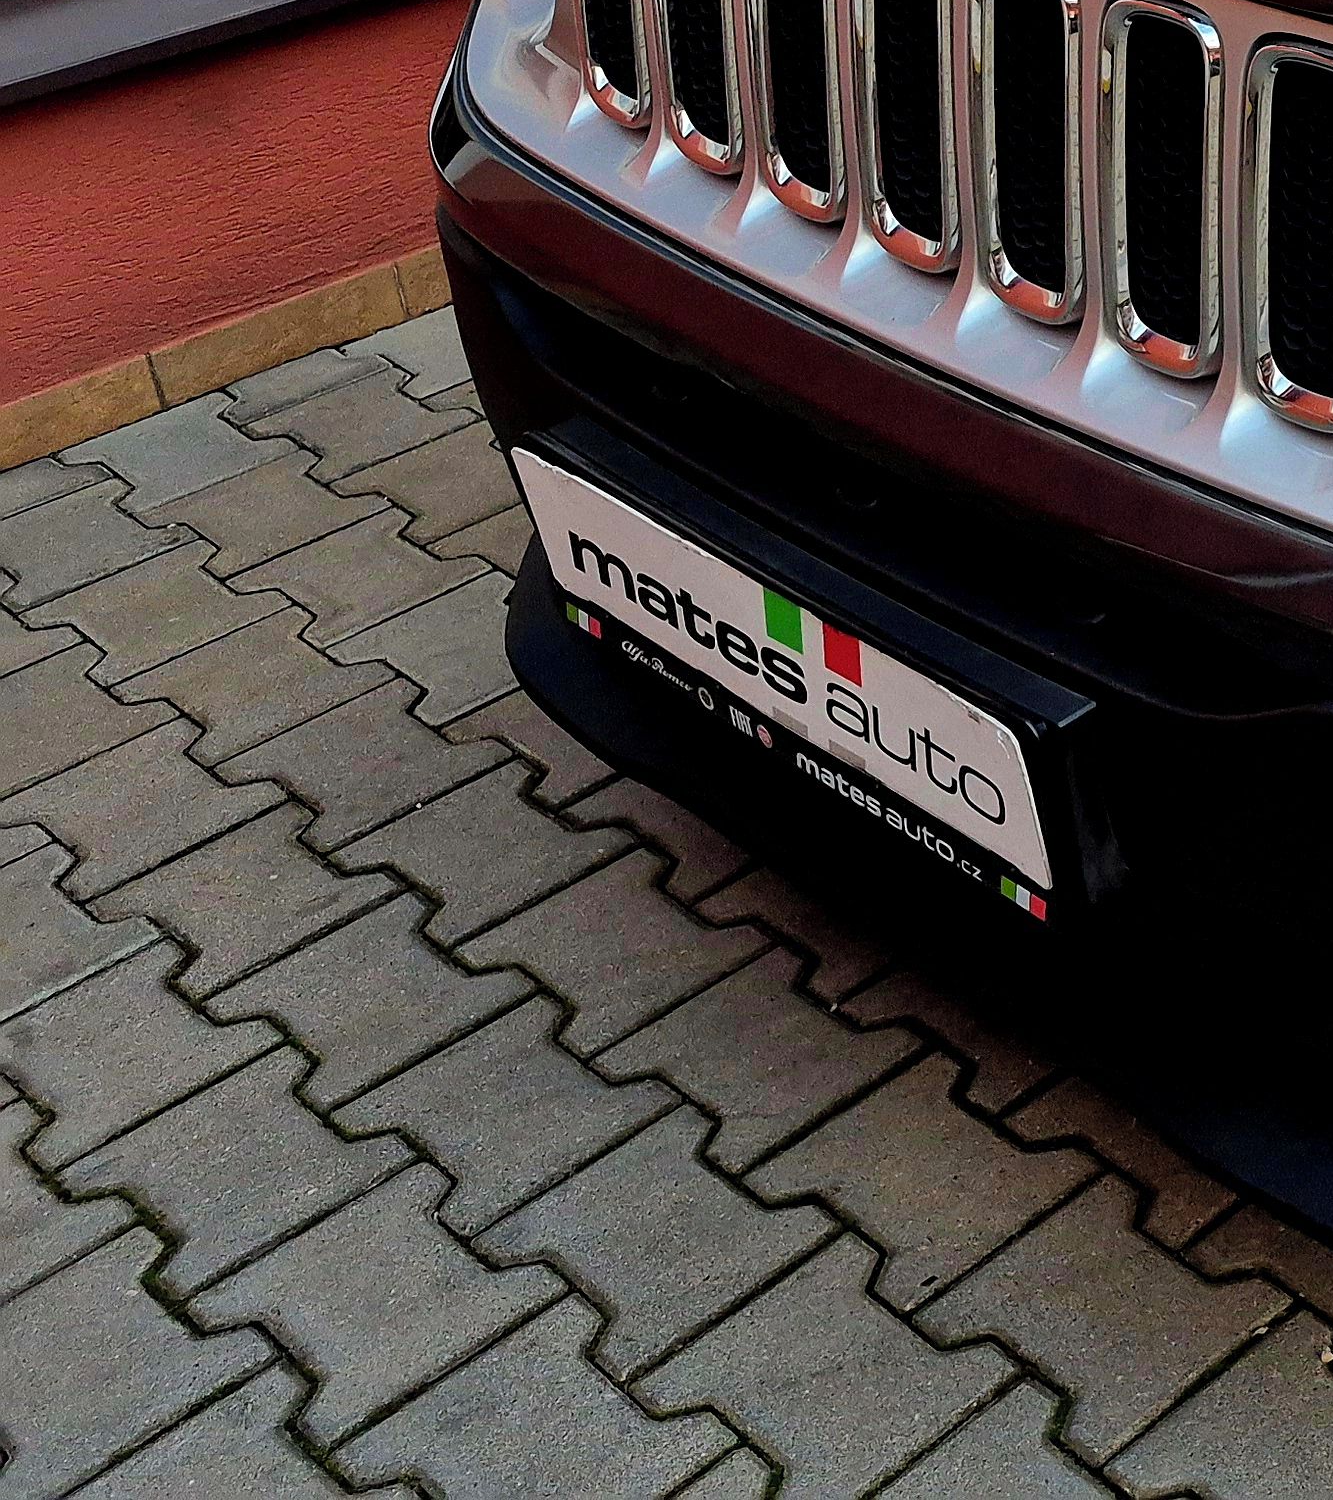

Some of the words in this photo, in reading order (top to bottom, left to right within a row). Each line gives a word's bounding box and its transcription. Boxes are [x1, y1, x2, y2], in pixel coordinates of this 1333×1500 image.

[568, 529, 808, 705] mates
[825, 682, 1007, 826] auto
[728, 704, 754, 738] FIAT
